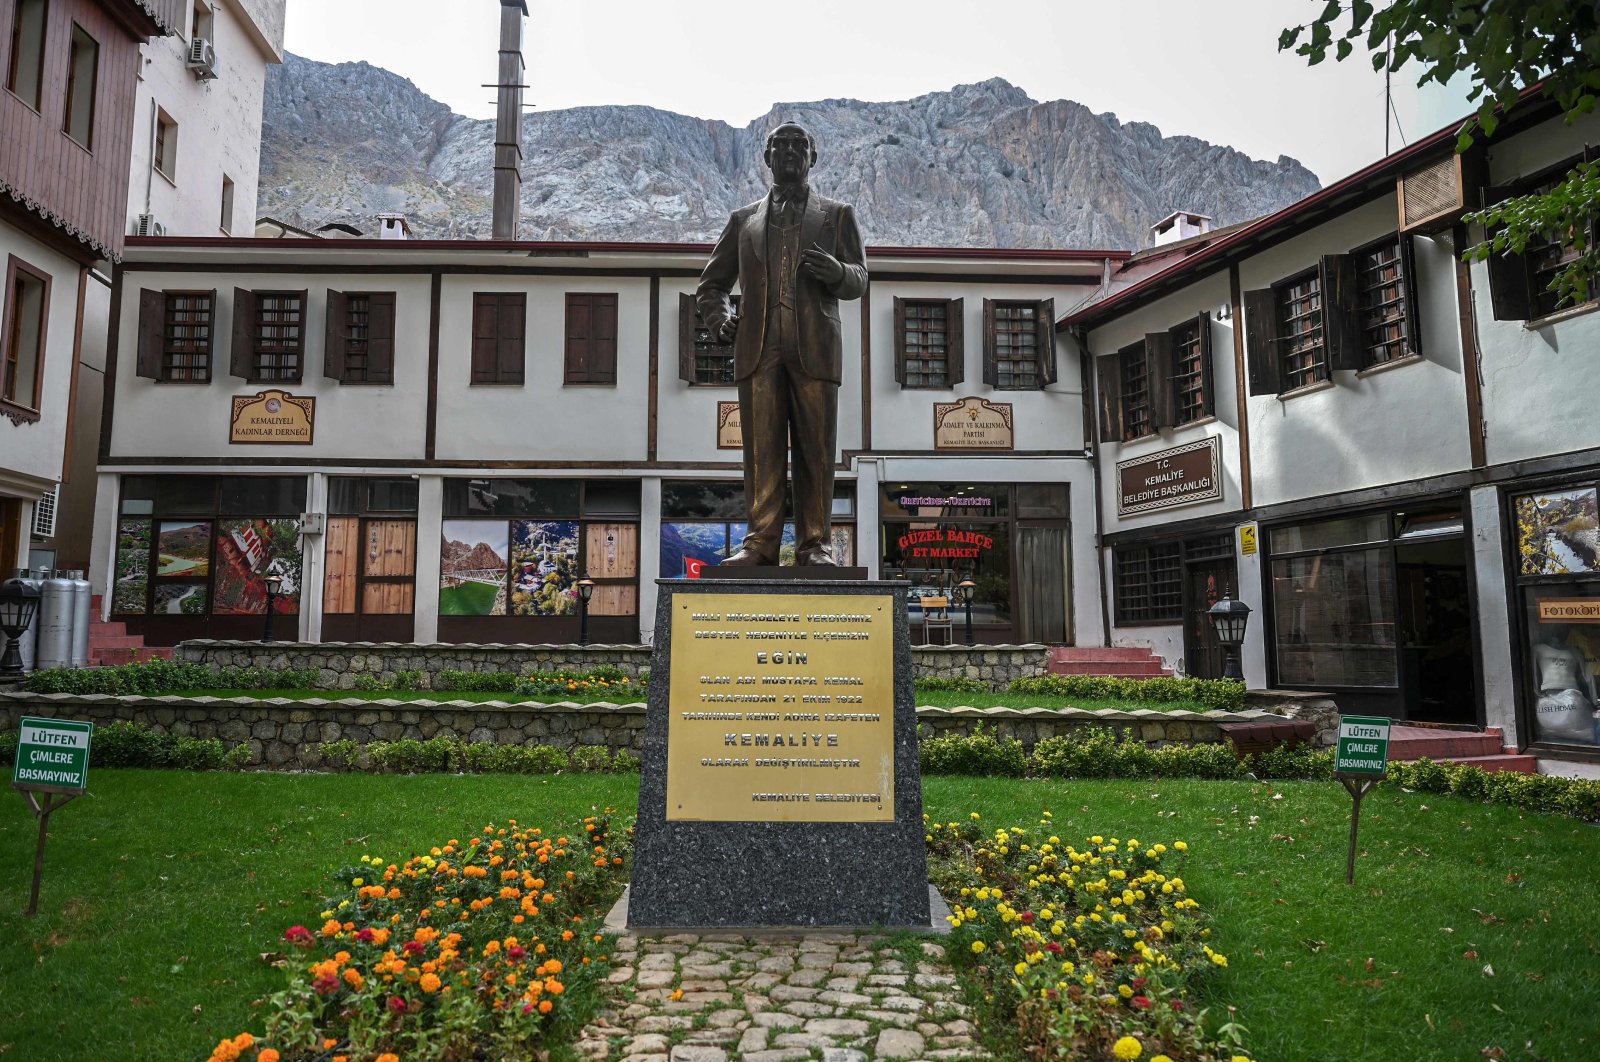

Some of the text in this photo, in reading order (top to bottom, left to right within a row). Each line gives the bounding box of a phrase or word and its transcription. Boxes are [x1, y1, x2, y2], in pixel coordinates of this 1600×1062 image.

[250, 416, 294, 425] KEMALİYELİ
[235, 428, 308, 436] KADINLAR DERNEĞİ
[1145, 469, 1184, 487] KEMALİYE
[1123, 477, 1211, 505] BELEDİYE BAŞKANLIĞI
[899, 530, 993, 549] GÜZEL BAHÇE
[913, 548, 980, 558] ET MARKET
[726, 612, 800, 622] MÜCADELEYE
[695, 630, 740, 639] DESTEK
[746, 630, 807, 640] NEDENİYLE
[700, 676, 864, 686] OLAN ADI MUSTAFA KEMAL
[700, 694, 776, 702] TARAFINDAN
[783, 694, 796, 702] 21
[836, 695, 863, 704] 1922
[1349, 726, 1380, 738] LÜTFEN
[32, 730, 76, 746] LÜTFEN
[724, 732, 838, 746] KEMALİYE
[1347, 743, 1378, 754] ÇİMLERE
[30, 750, 74, 764] ÇİMLERE
[701, 758, 748, 766] OLARAK
[1340, 759, 1382, 769] BASMAYINIZ
[18, 768, 80, 784] BASMAYINIZ
